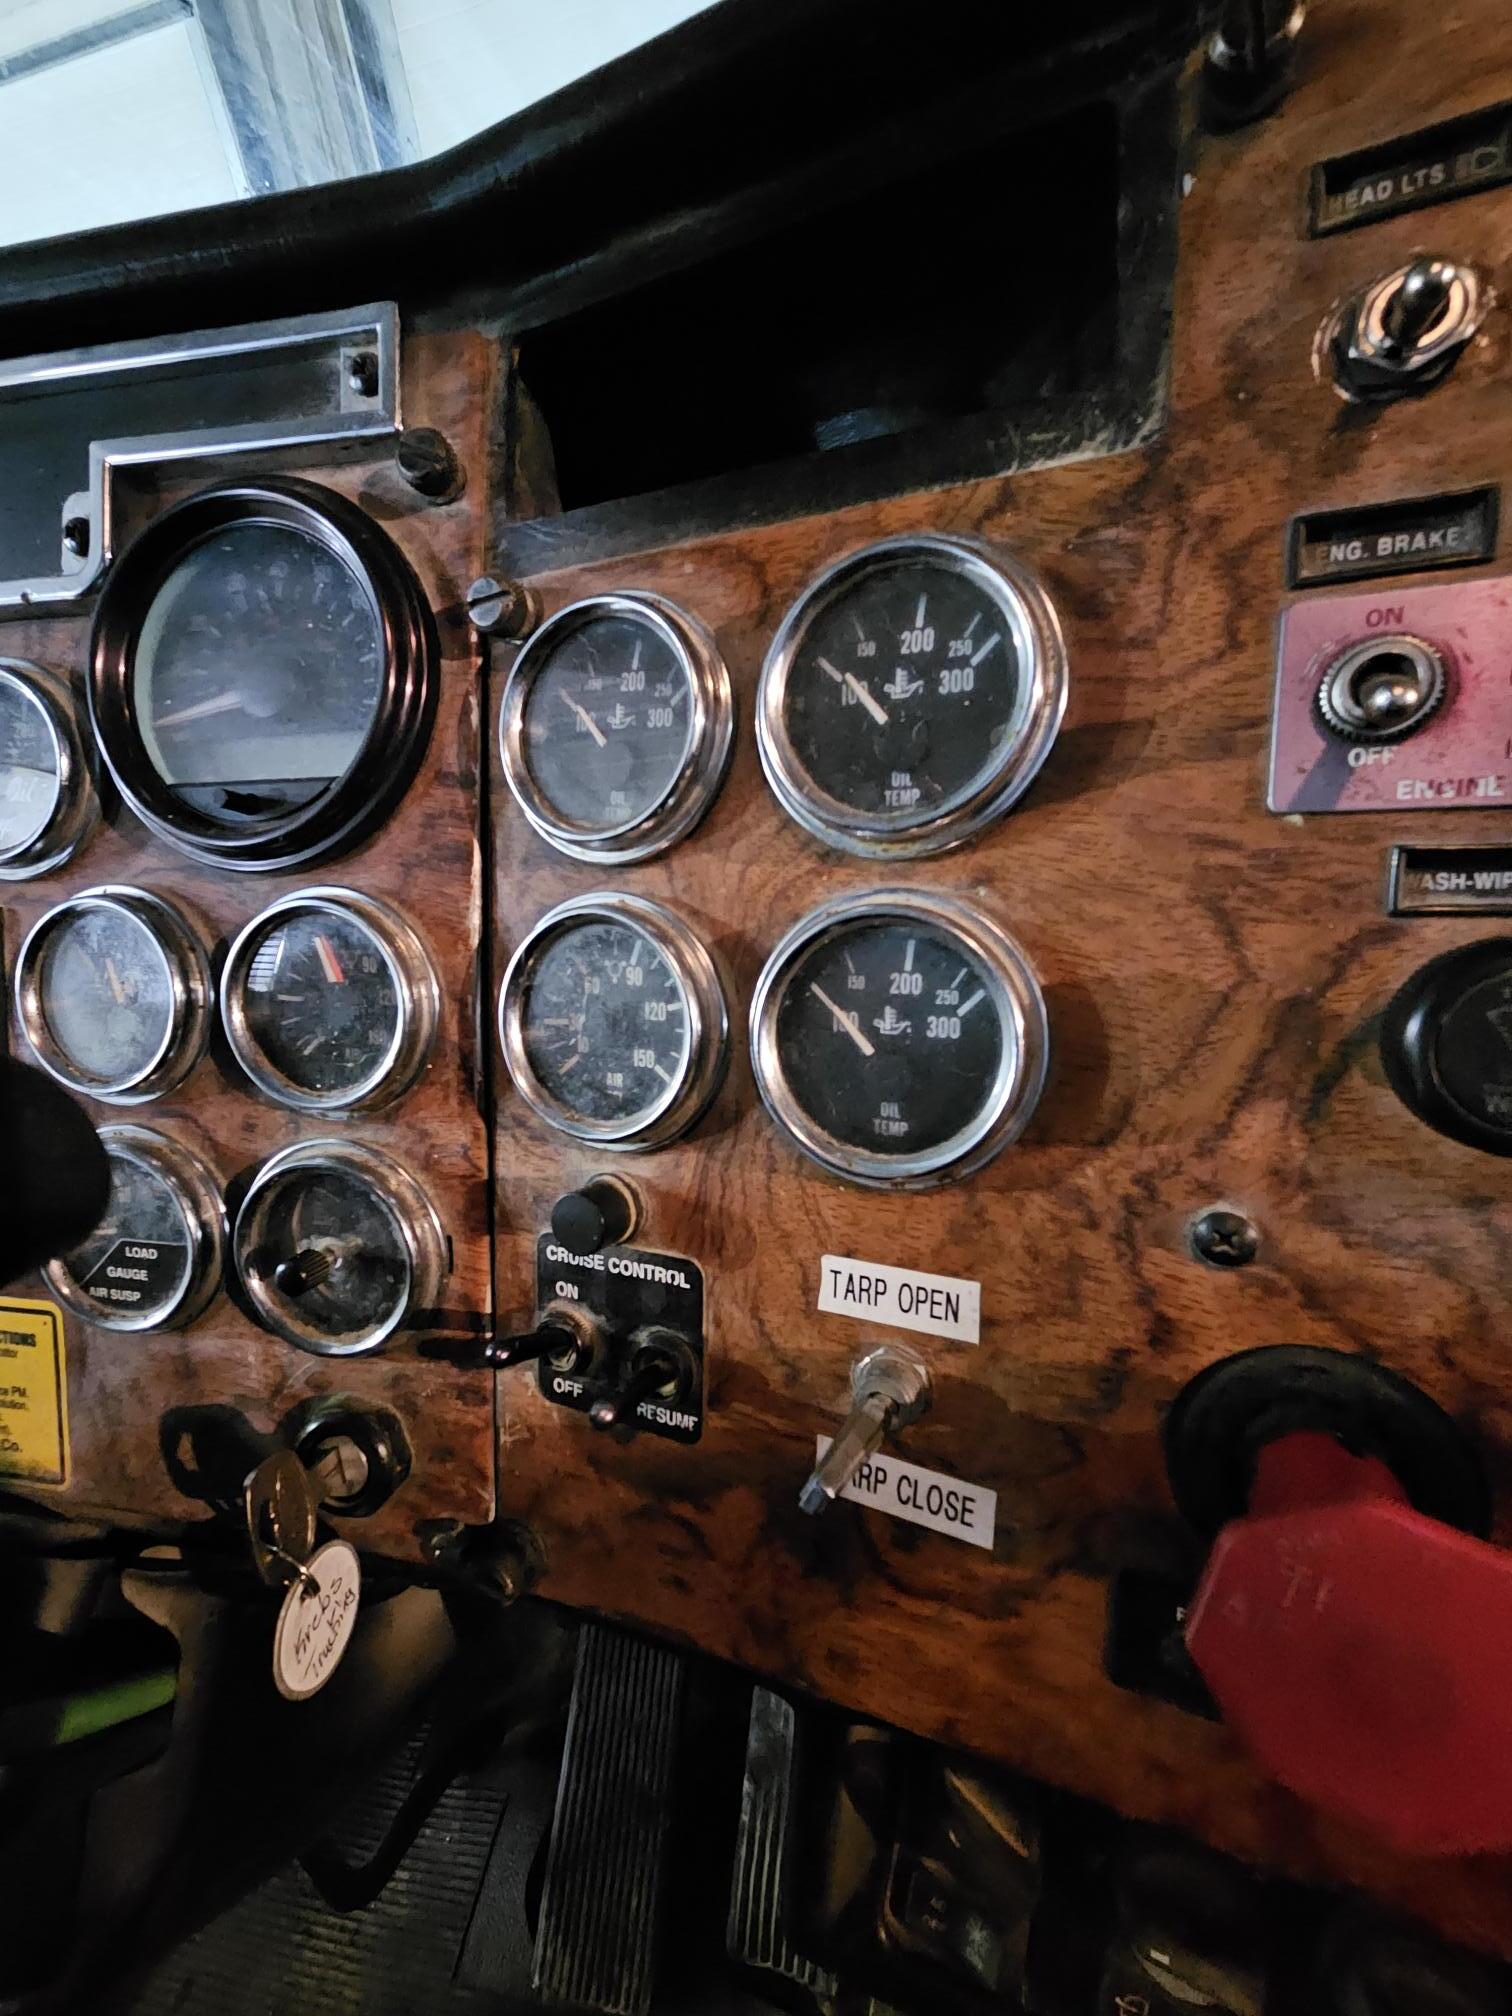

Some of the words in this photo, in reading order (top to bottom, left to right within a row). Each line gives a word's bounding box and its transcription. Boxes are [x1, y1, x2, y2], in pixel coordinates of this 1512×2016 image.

[1402, 163, 1446, 194] LTS
[1377, 527, 1461, 557] BRAKE
[1366, 606, 1405, 628] ON
[900, 629, 935, 654] 200
[949, 639, 973, 658] 250
[620, 671, 645, 692] 200
[938, 668, 974, 695] 300
[647, 707, 674, 728] 300
[1347, 746, 1396, 767] OFF
[891, 771, 913, 787] OIL
[884, 789, 921, 807] TEMP
[625, 967, 643, 986] 90
[889, 973, 923, 996] 200
[935, 989, 960, 1006] 250
[645, 1001, 667, 1022] 120
[926, 1015, 962, 1040] 300
[633, 1049, 655, 1069] 150
[606, 1072, 624, 1088] AIR
[880, 1102, 901, 1119] OIL
[873, 1119, 910, 1138] TEMP
[125, 1246, 158, 1260] LOAD
[106, 1266, 149, 1281] GAUGE
[546, 1245, 605, 1271] CRUISE
[607, 1257, 691, 1290] CONTROL
[89, 1286, 108, 1299] AIR
[110, 1288, 141, 1302] SUSP
[555, 1280, 579, 1300] ON
[829, 1269, 888, 1307] TARP
[898, 1282, 961, 1324] OPEN
[553, 1377, 583, 1398] OFF
[636, 1402, 699, 1431] RESUME
[851, 1461, 888, 1495] RP
[896, 1474, 977, 1528] CLOSE
